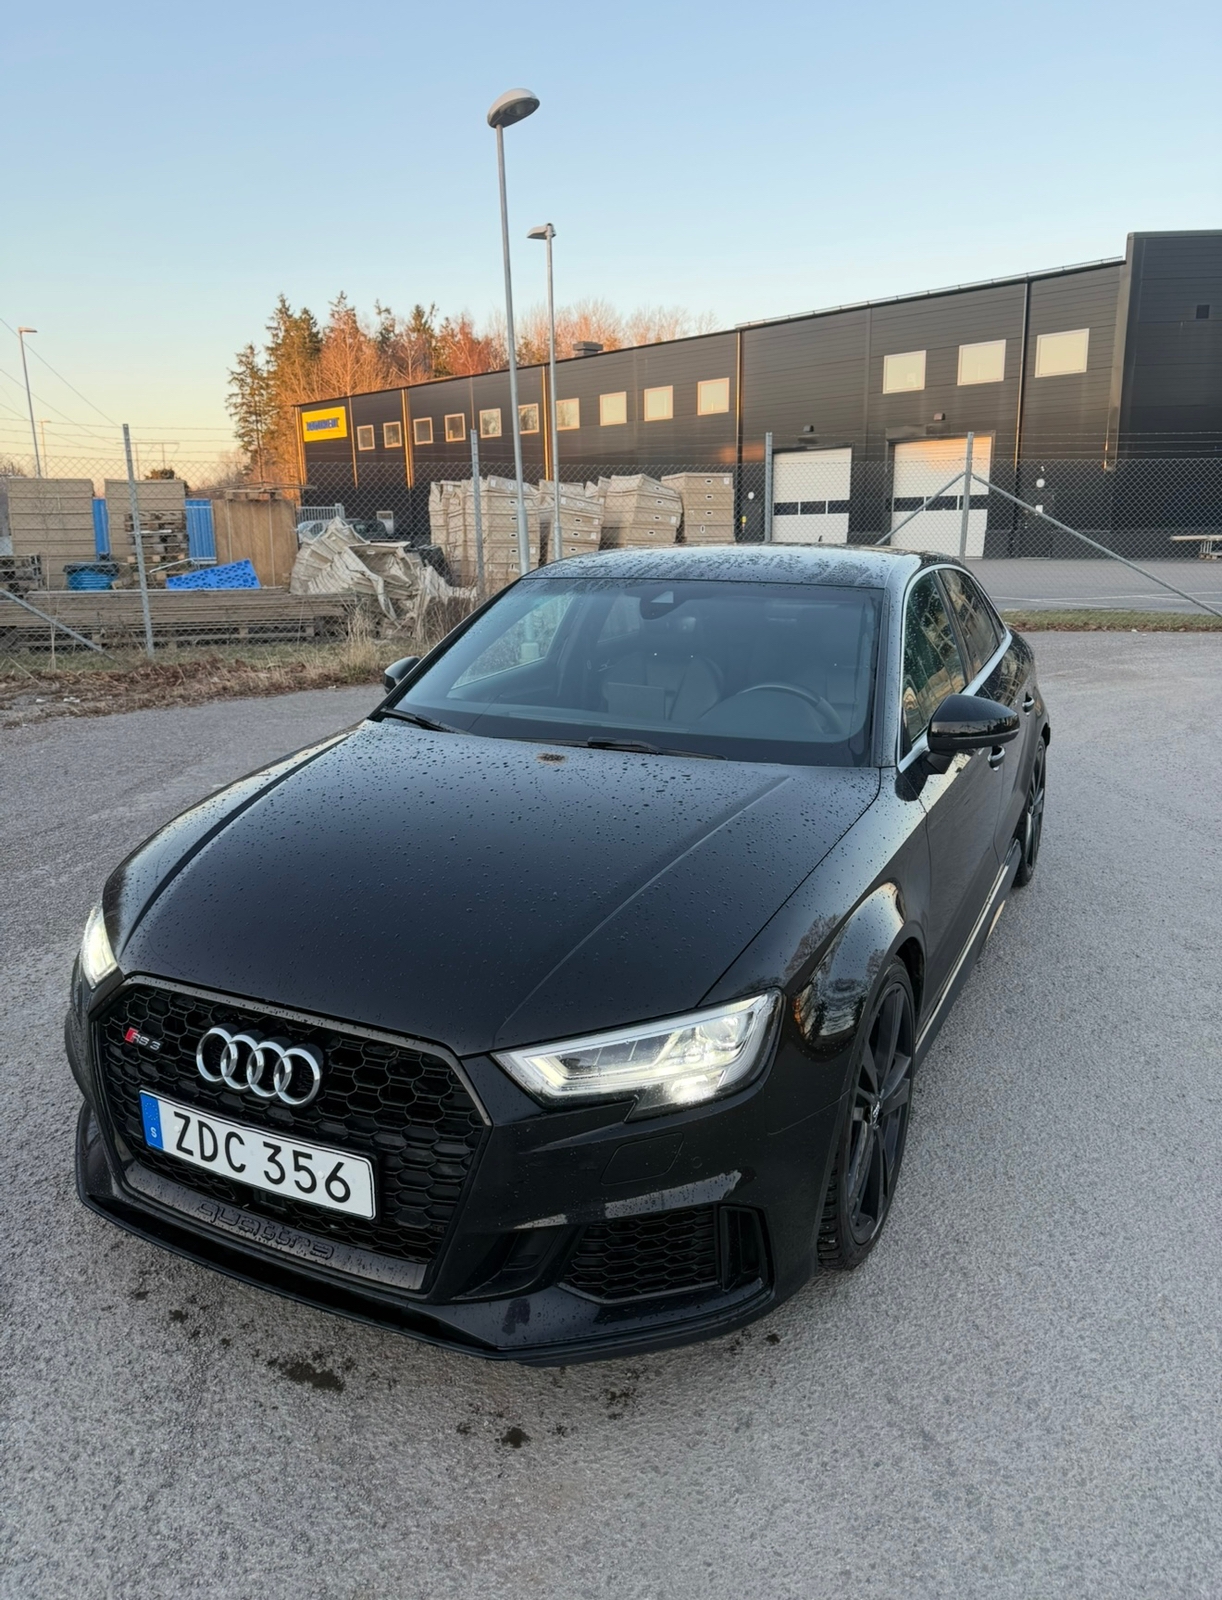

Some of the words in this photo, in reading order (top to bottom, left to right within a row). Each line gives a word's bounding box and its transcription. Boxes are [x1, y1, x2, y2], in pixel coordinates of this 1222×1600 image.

[150, 1126, 158, 1138] S
[173, 1111, 246, 1173] ZDC
[262, 1141, 351, 1203] 356
[197, 1202, 334, 1260] quattro
